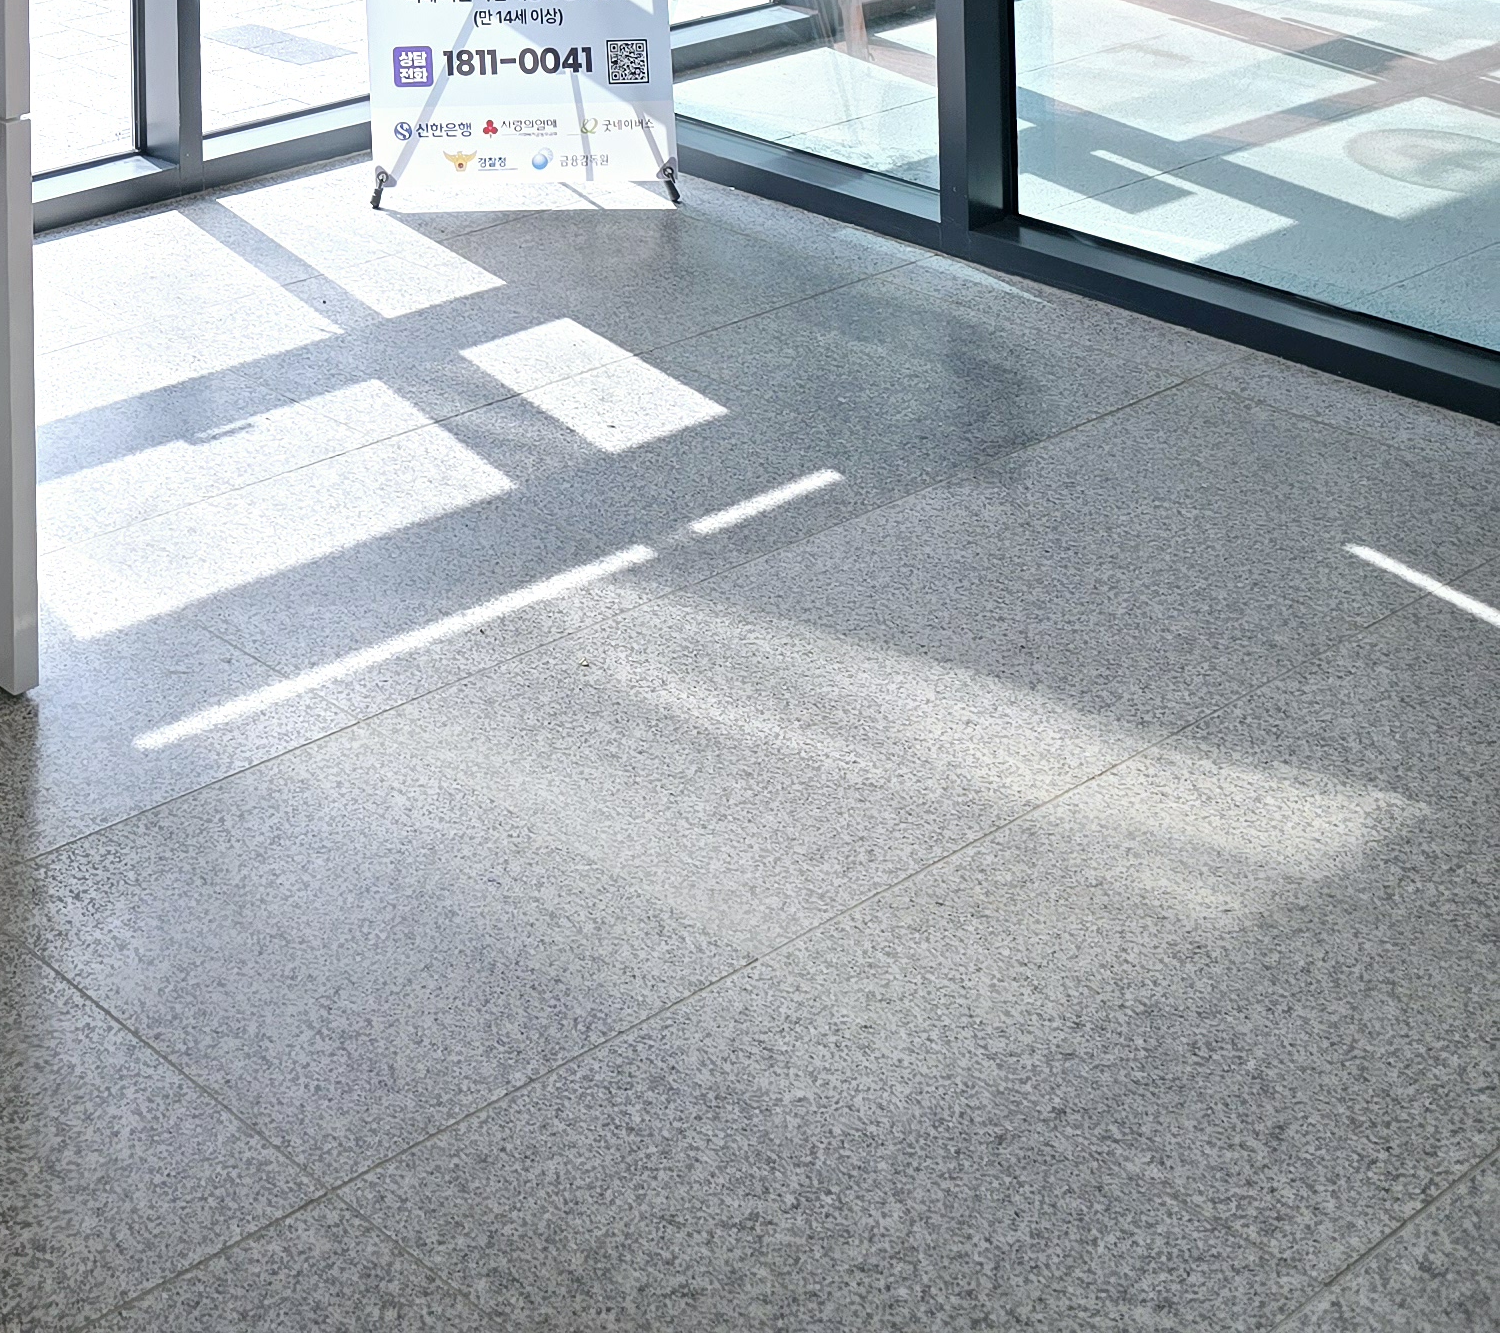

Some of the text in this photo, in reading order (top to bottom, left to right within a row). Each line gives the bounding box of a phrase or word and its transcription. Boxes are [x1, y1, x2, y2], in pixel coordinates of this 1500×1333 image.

[473, 8, 563, 28] (만 14세 이상)
[399, 52, 427, 67] 상담
[442, 47, 593, 77] 1811-0041
[399, 67, 428, 84] 전화
[416, 121, 472, 138] 신한은행
[602, 119, 655, 133] 굿네이버스
[477, 157, 507, 168] 경찰청
[559, 153, 609, 168] 금융감독원
